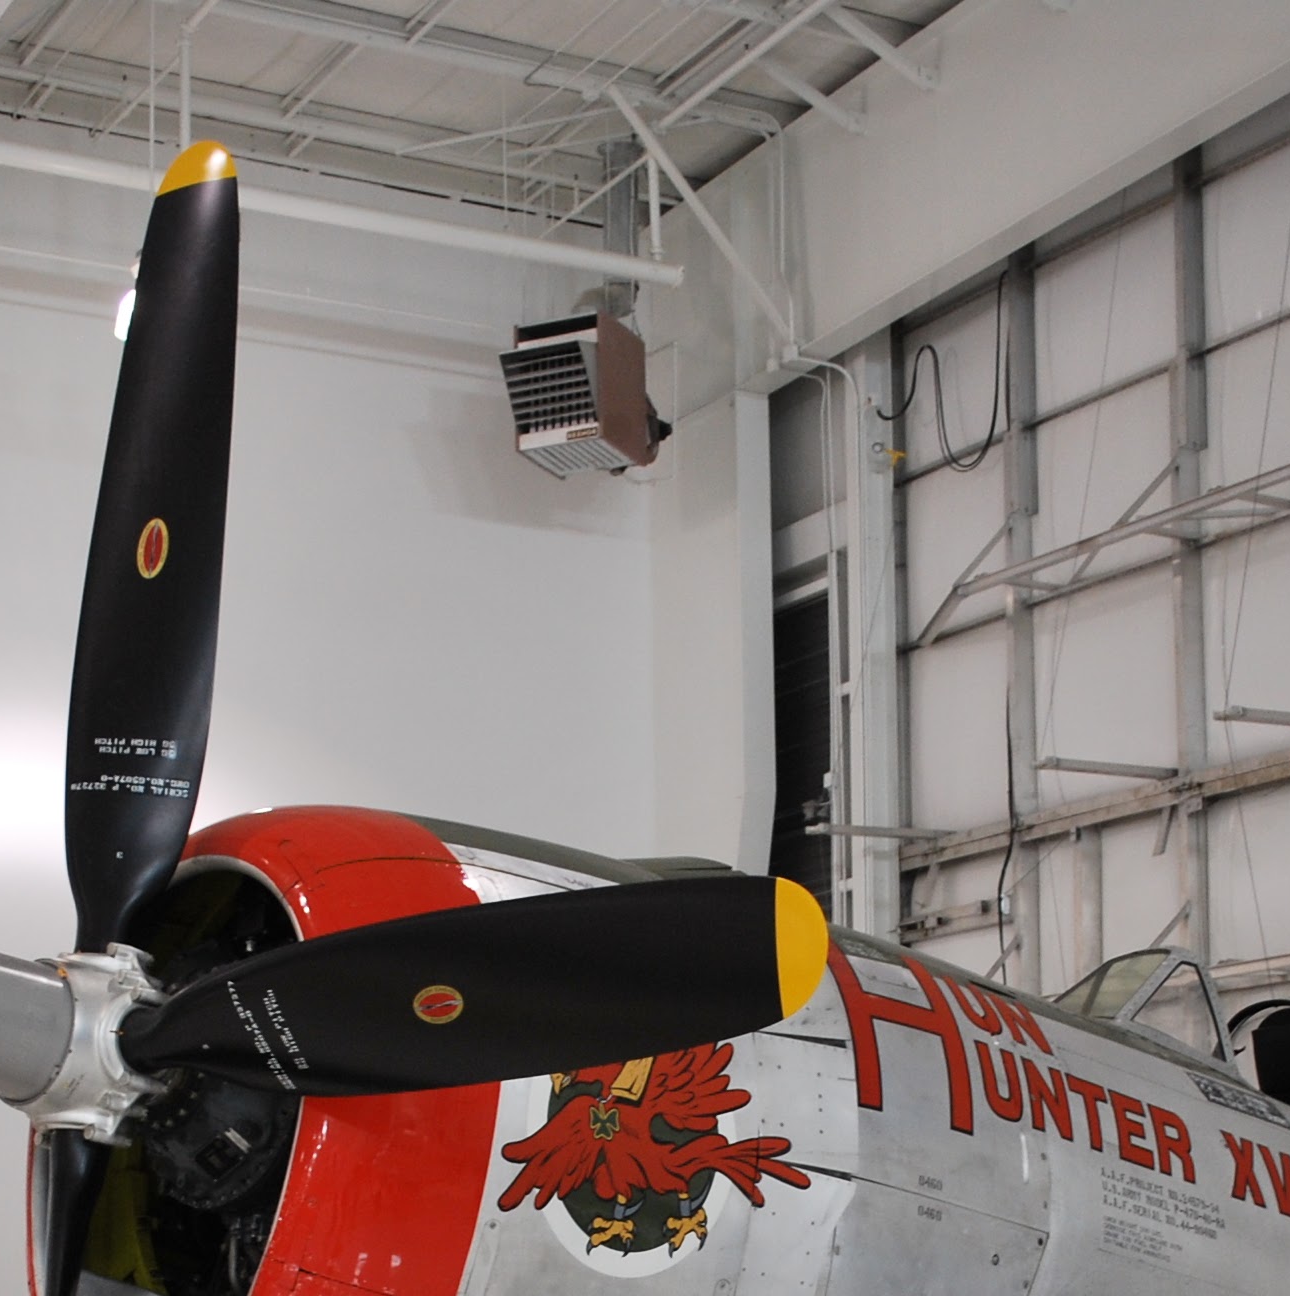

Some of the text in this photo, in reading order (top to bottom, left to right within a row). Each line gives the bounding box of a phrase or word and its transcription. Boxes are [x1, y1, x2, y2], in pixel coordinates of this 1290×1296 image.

[94, 737, 125, 745] PITCH
[99, 746, 130, 754] PITCH
[918, 1175, 943, 1191] 0460
[917, 1205, 942, 1221] 0460
